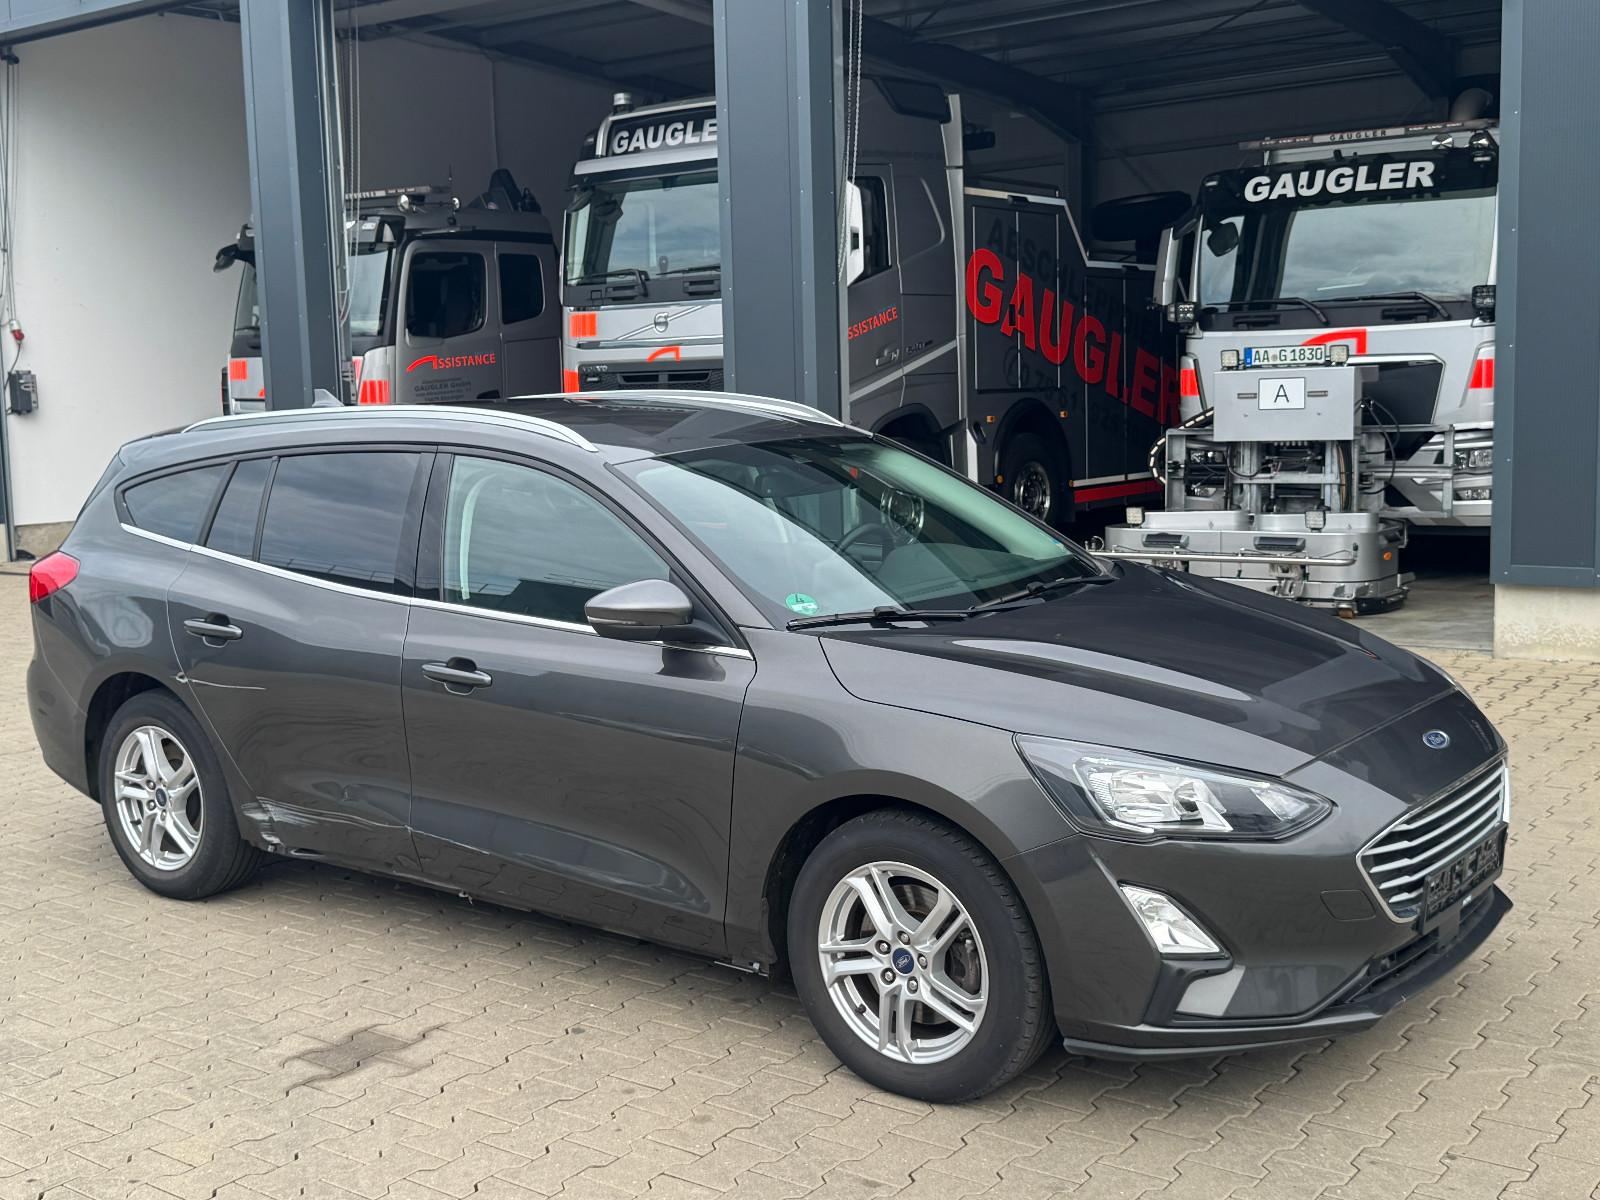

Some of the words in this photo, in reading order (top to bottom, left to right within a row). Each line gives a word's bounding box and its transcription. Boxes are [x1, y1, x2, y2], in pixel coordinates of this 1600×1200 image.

[1330, 130, 1387, 142] GAUGLER
[1244, 161, 1435, 202] GAUGLER
[965, 247, 1181, 426] GAUGLER
[1254, 350, 1270, 363] AA
[1274, 385, 1289, 403] A
